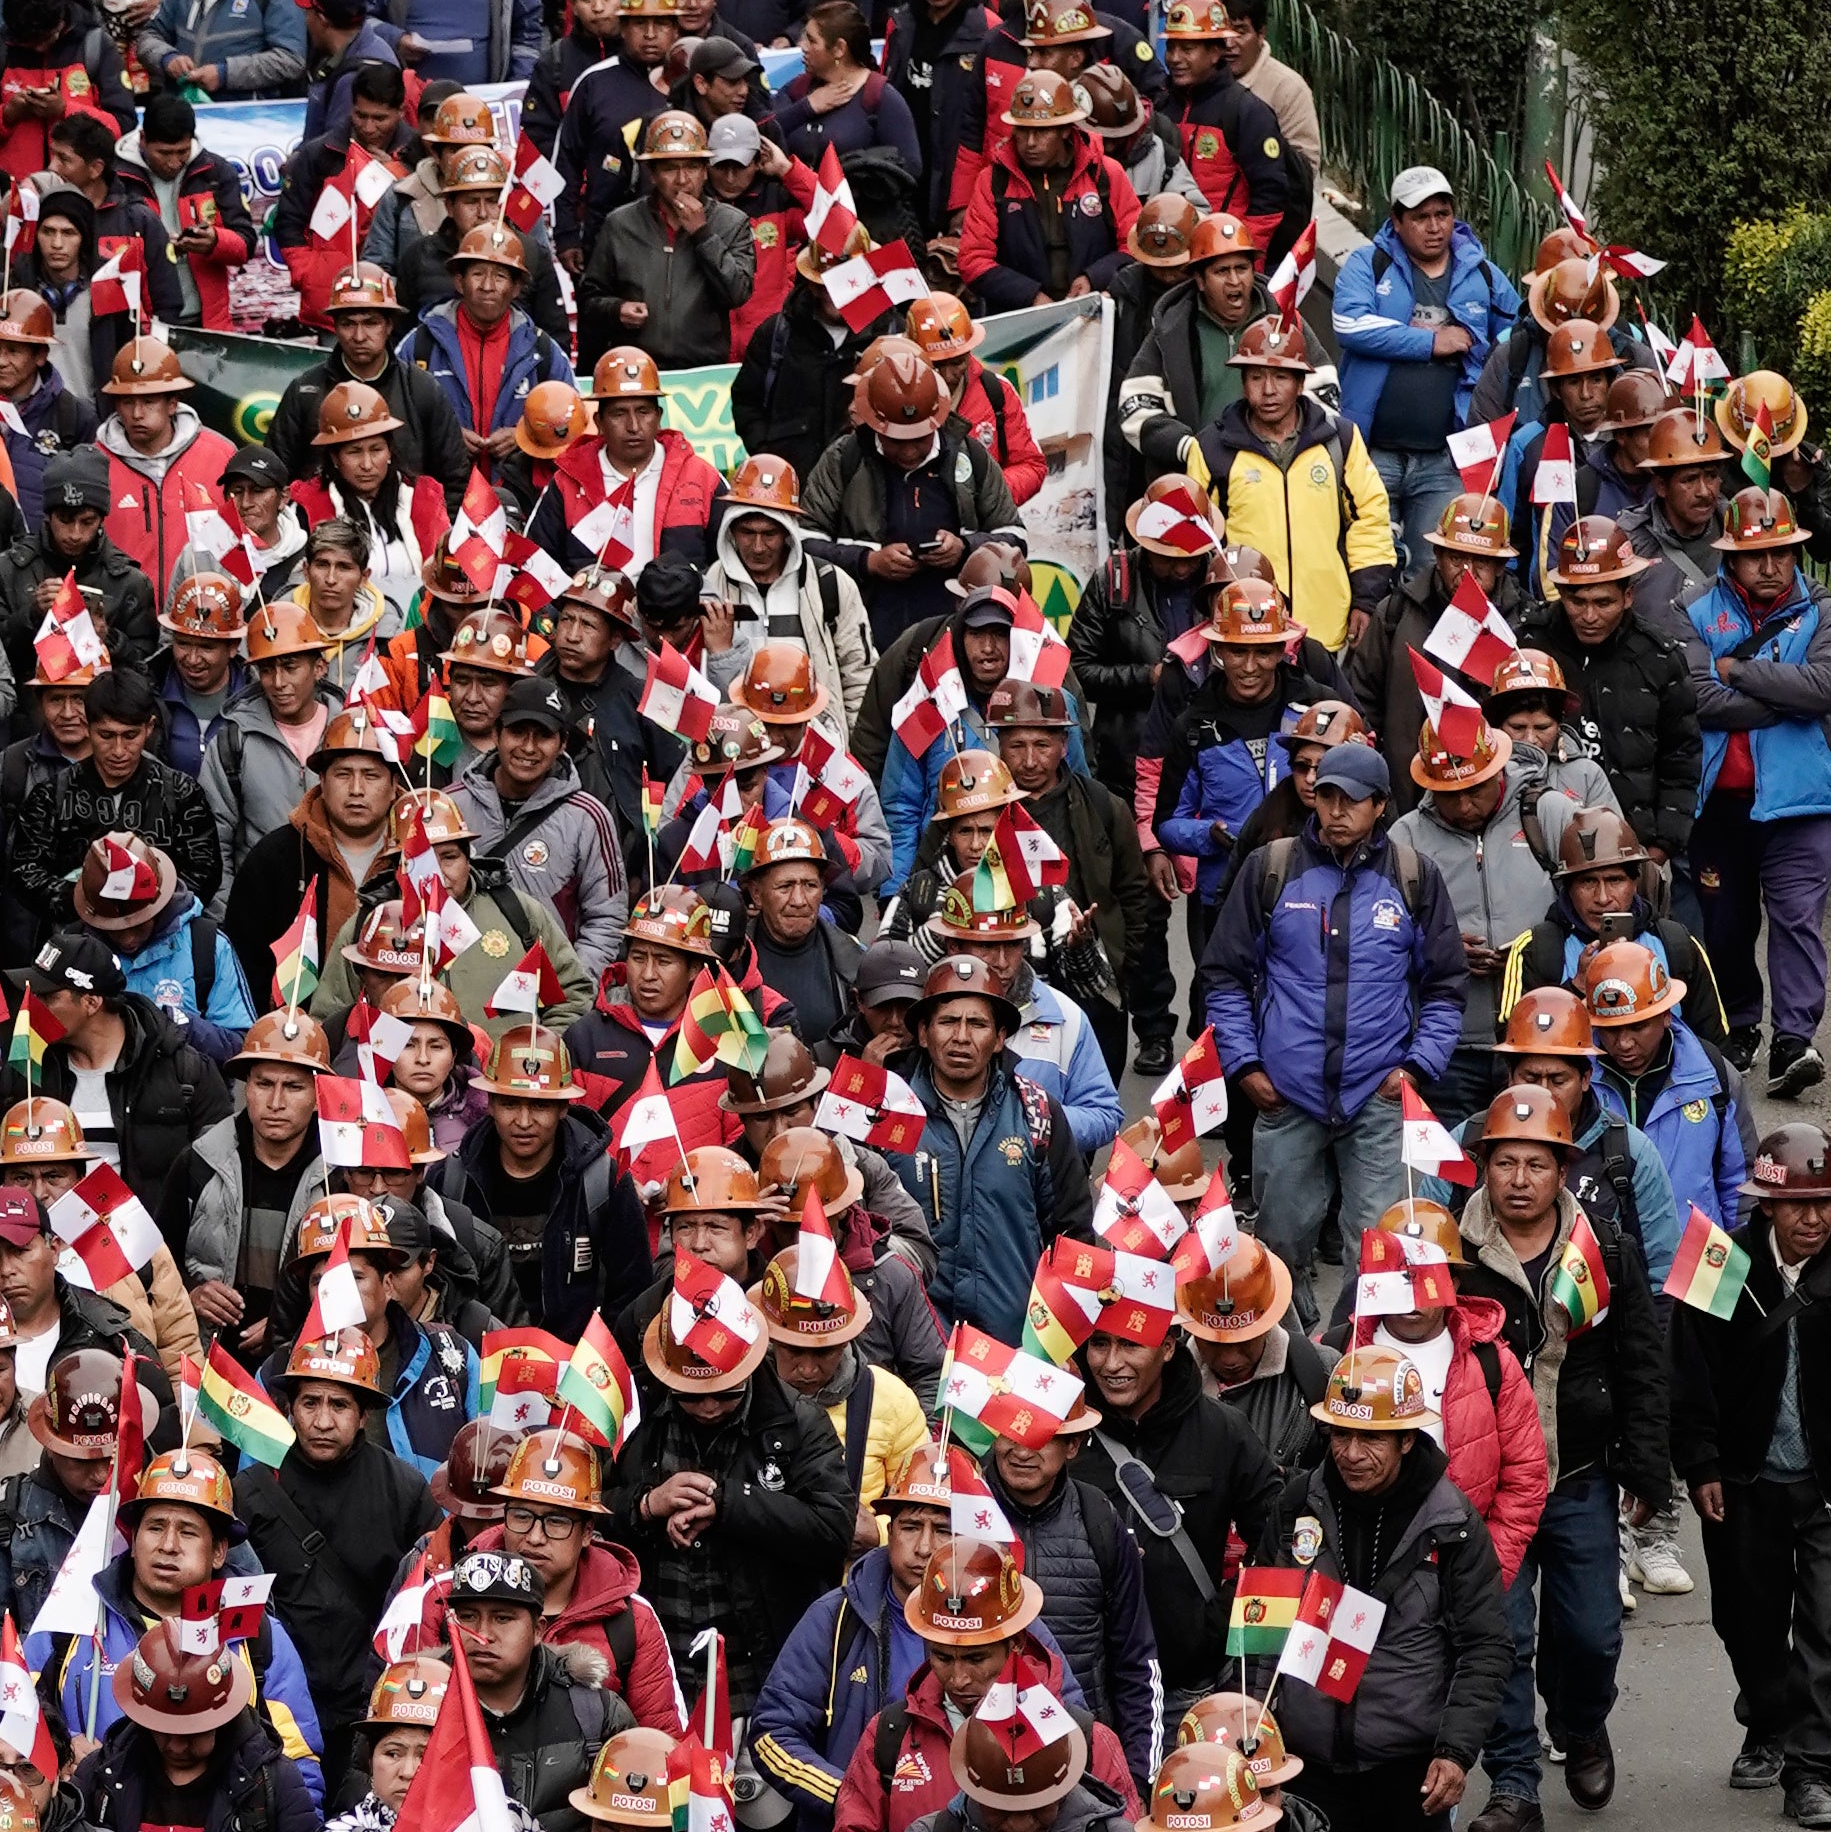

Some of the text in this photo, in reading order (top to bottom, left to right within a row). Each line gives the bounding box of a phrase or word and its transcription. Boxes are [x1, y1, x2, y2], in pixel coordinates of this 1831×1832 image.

[378, 949, 420, 966] POTOSI
[15, 1140, 55, 1155] POTOSI
[799, 1315, 848, 1334] POTOSI
[1202, 1310, 1255, 1330] POTOSI
[1329, 1401, 1373, 1421] POTOSI
[73, 1432, 114, 1447] POTOSI
[157, 1480, 199, 1496] POTOSI
[521, 1478, 577, 1500] POTOSI
[932, 1612, 983, 1631] POTOSI
[392, 1703, 436, 1719] POTOSI
[612, 1794, 655, 1812] POTOSI
[1167, 1814, 1212, 1829] POTOSI
